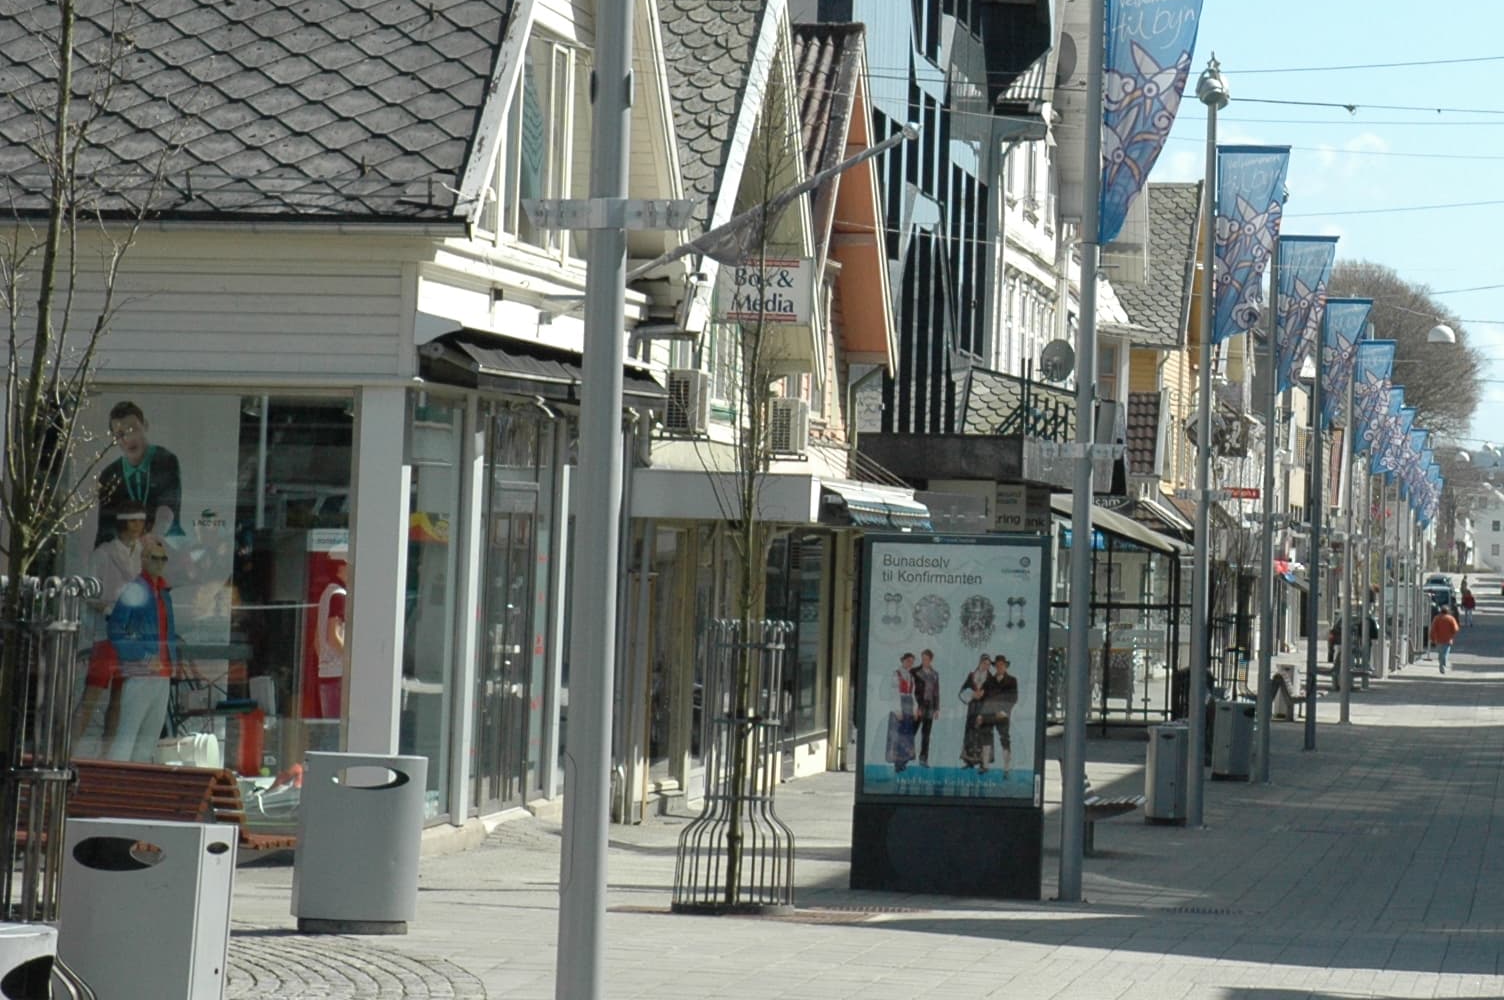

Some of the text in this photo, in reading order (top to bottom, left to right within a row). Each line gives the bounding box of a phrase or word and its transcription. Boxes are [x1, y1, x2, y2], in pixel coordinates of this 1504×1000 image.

[776, 269, 795, 288] &
[730, 292, 795, 313] Media
[192, 519, 226, 527] LACSTE
[882, 553, 951, 569] Bunadsølv
[882, 569, 983, 585] til Konfirmanten
